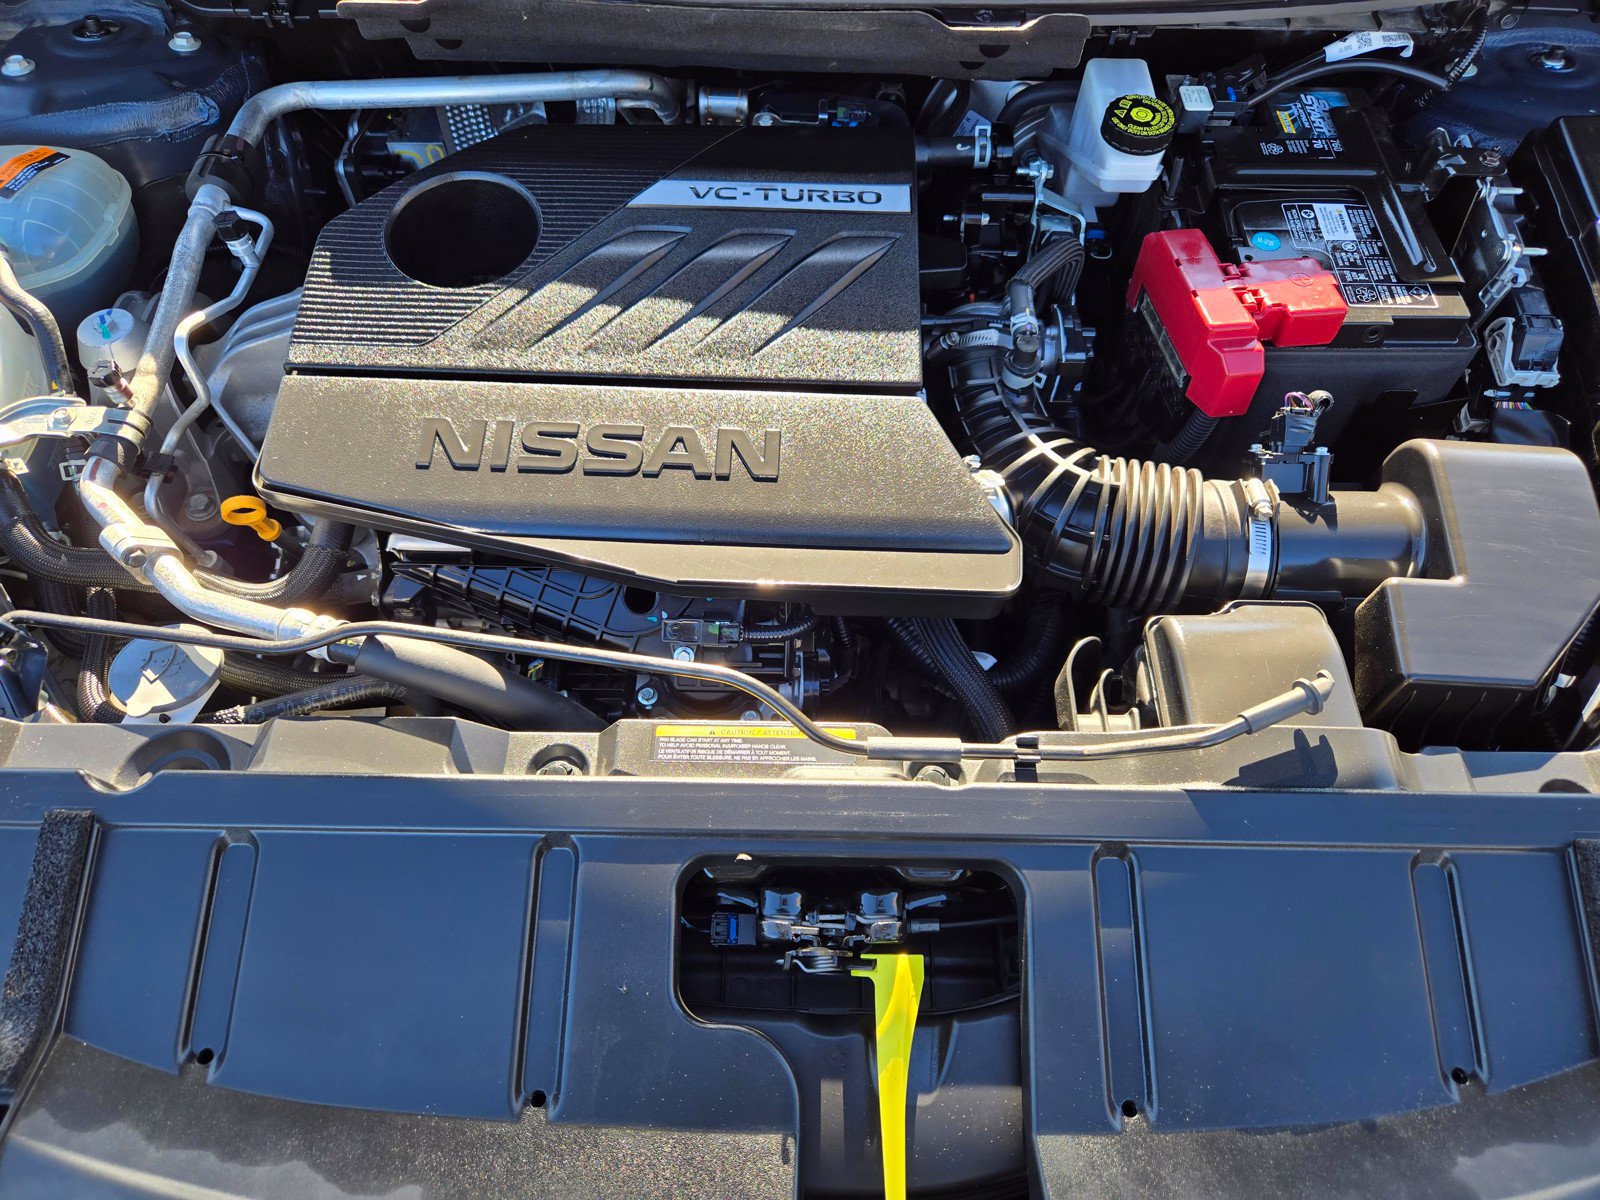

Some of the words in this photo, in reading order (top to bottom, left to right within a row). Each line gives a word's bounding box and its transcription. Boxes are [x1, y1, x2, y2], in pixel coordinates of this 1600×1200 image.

[1296, 102, 1310, 128] PLATINUM
[1299, 94, 1328, 134] START
[1311, 140, 1323, 148] 70
[1329, 139, 1343, 151] 760
[688, 185, 882, 205] VC-TURBO
[415, 416, 782, 483] NISSAN
